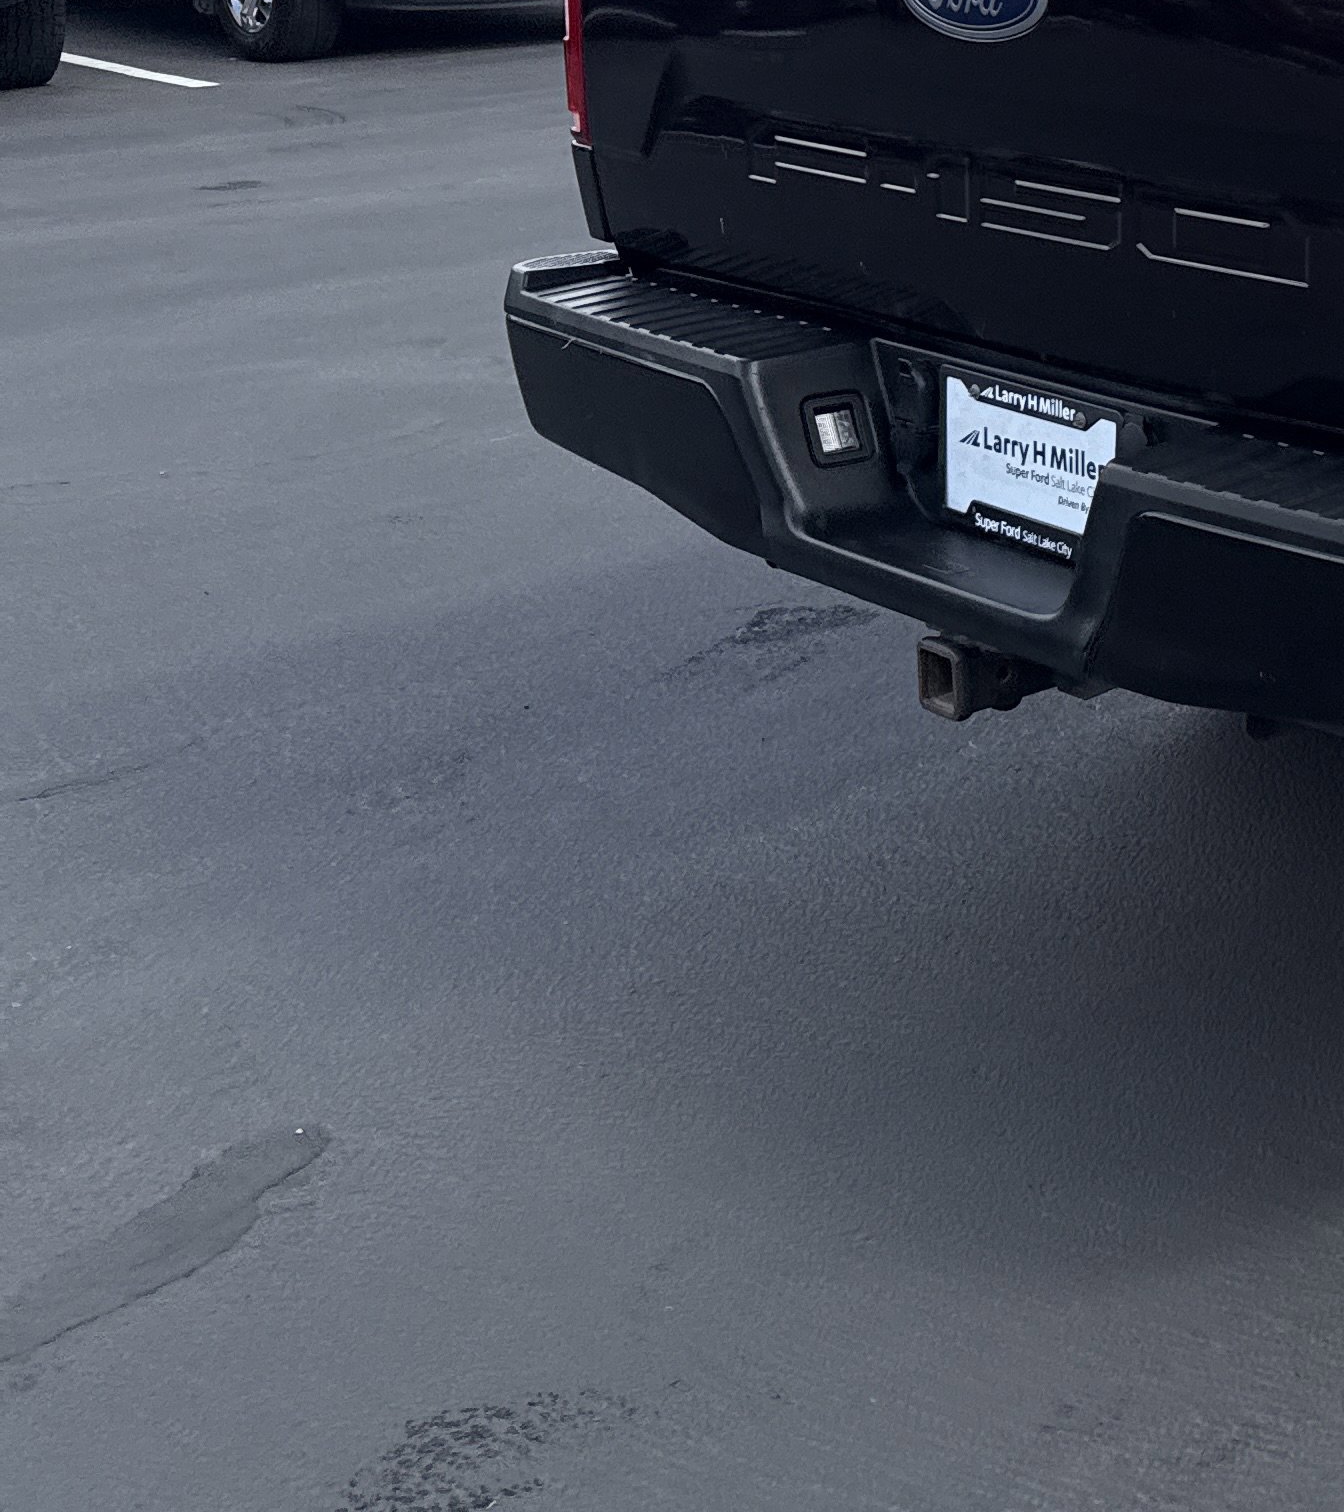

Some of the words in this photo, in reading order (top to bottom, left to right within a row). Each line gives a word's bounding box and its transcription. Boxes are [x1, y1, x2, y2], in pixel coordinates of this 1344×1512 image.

[995, 385, 1026, 411] Larry
[1028, 394, 1037, 410] H
[1038, 397, 1076, 421] Miller
[983, 426, 1029, 466] Larry
[1033, 440, 1046, 466] H
[1006, 462, 1029, 479] Super
[1031, 467, 1050, 485] Ford
[1051, 474, 1065, 490] Salt
[1067, 480, 1086, 496] Lake
[975, 512, 999, 533] Super
[1001, 520, 1021, 539] Ford
[1022, 529, 1037, 546] Salt
[1038, 534, 1055, 551] Lake
[1056, 540, 1073, 559] City
